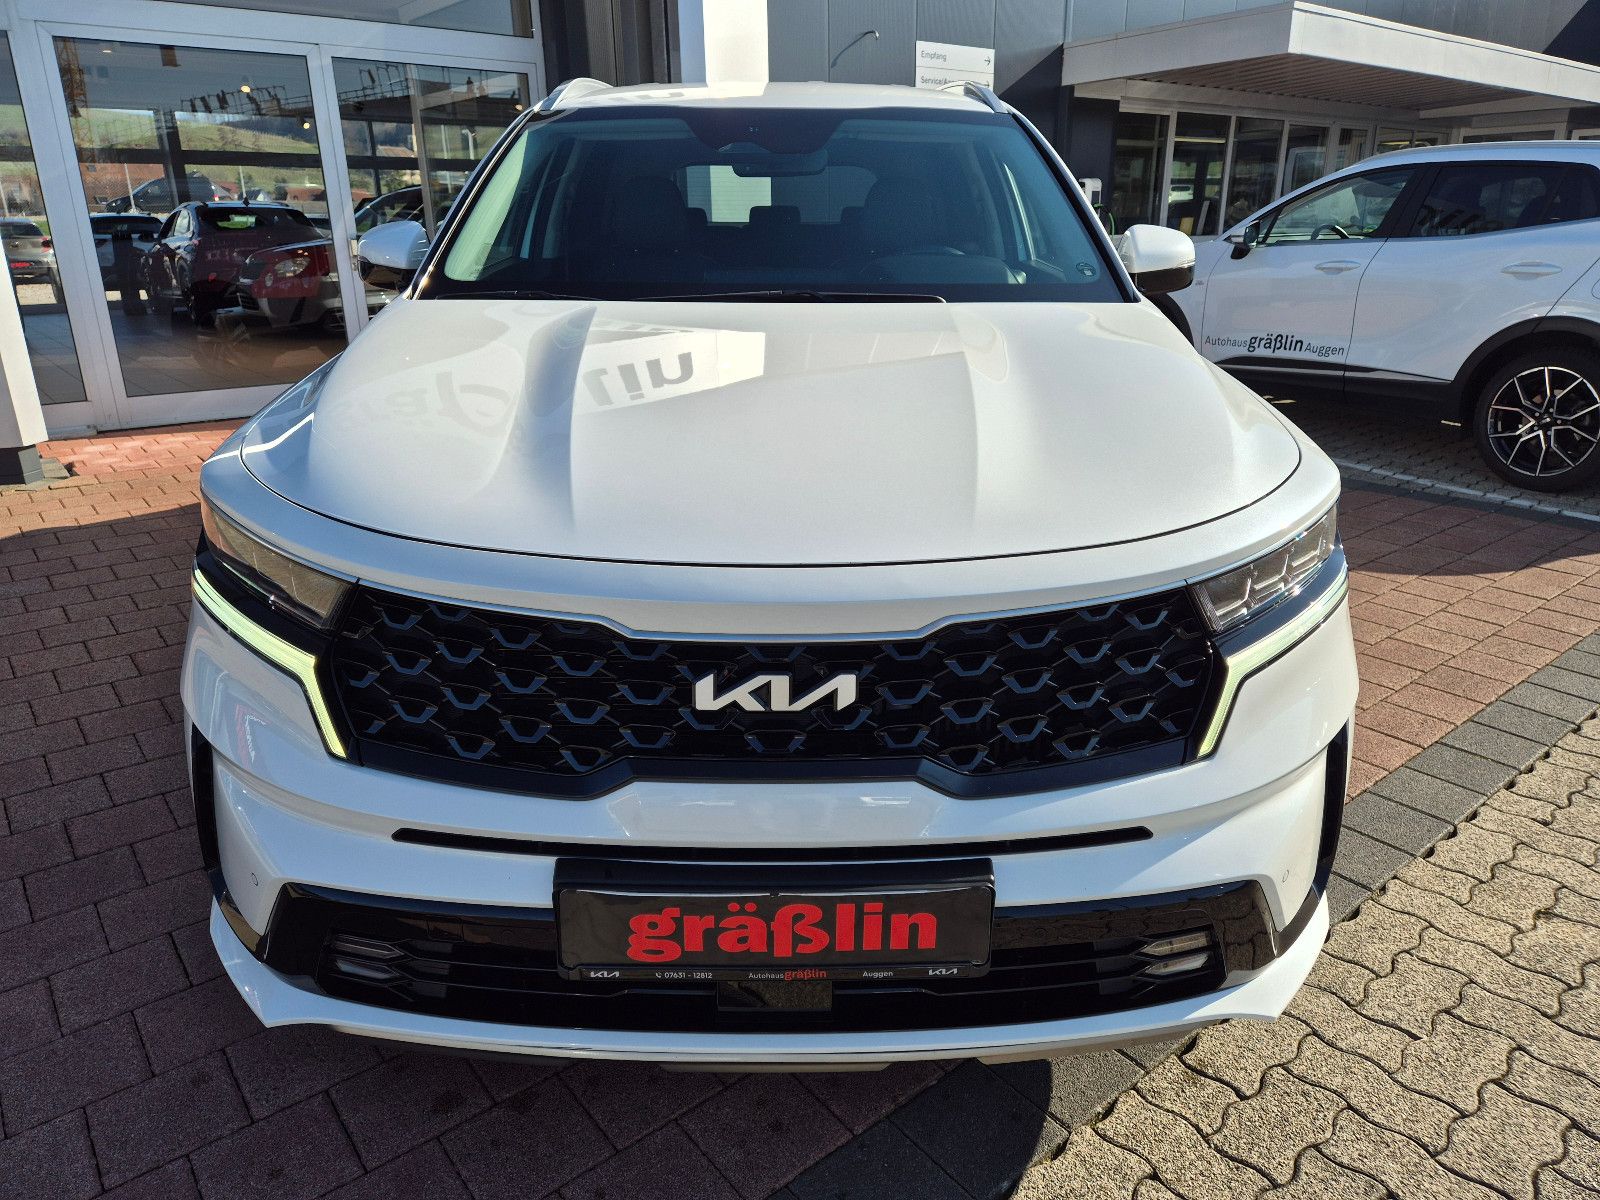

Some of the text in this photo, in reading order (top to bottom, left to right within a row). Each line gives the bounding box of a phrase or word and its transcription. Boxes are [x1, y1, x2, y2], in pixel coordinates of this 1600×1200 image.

[920, 50, 947, 62] Empfang
[1204, 333, 1345, 358] Autohaus gräßlin Auggen
[692, 672, 858, 712] KIA
[626, 902, 938, 963] gräßlin
[590, 970, 620, 978] KIA
[664, 970, 686, 979] 07631
[693, 970, 713, 979] 12812
[784, 969, 827, 981] gräßlin
[862, 970, 894, 979] Auggen
[928, 968, 958, 976] KIA
